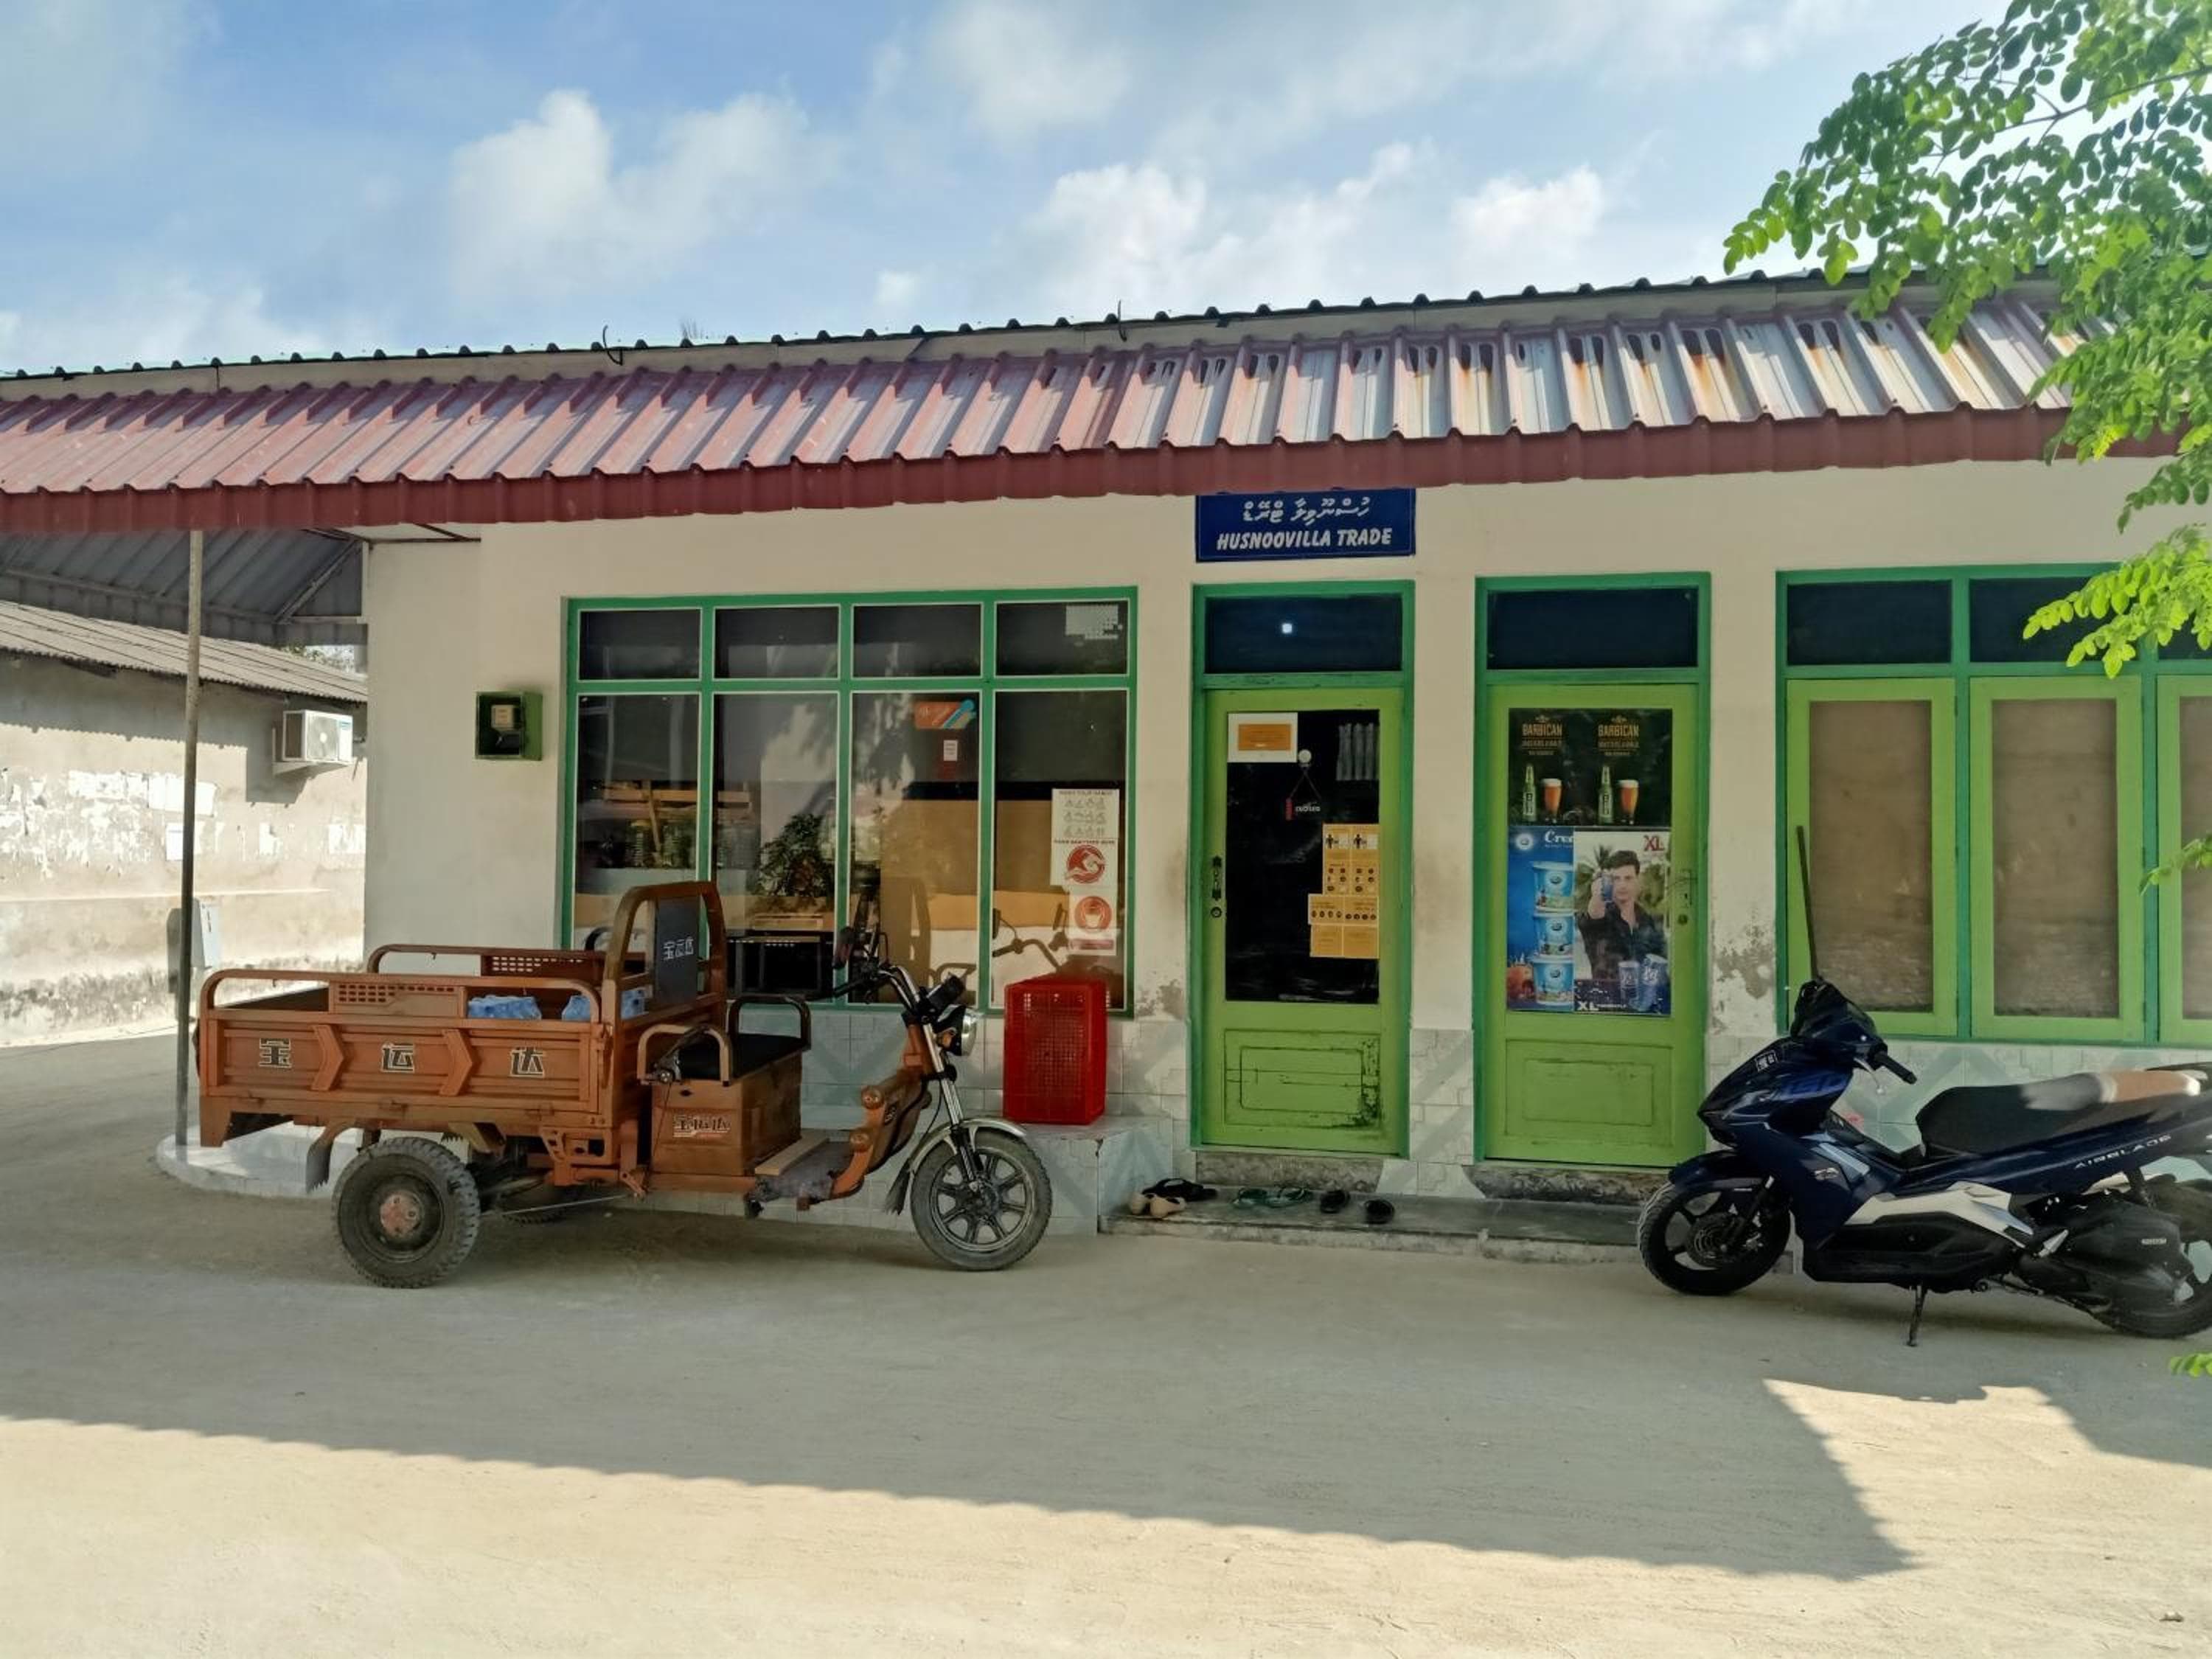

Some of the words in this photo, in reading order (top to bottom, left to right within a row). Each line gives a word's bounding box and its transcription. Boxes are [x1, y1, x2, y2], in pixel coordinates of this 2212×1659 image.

[1217, 529, 1331, 551] HUSNOOVILLA
[1337, 527, 1393, 546] TRADE
[1598, 725, 1640, 737] BARBICAN
[1644, 835, 1665, 852] XL
